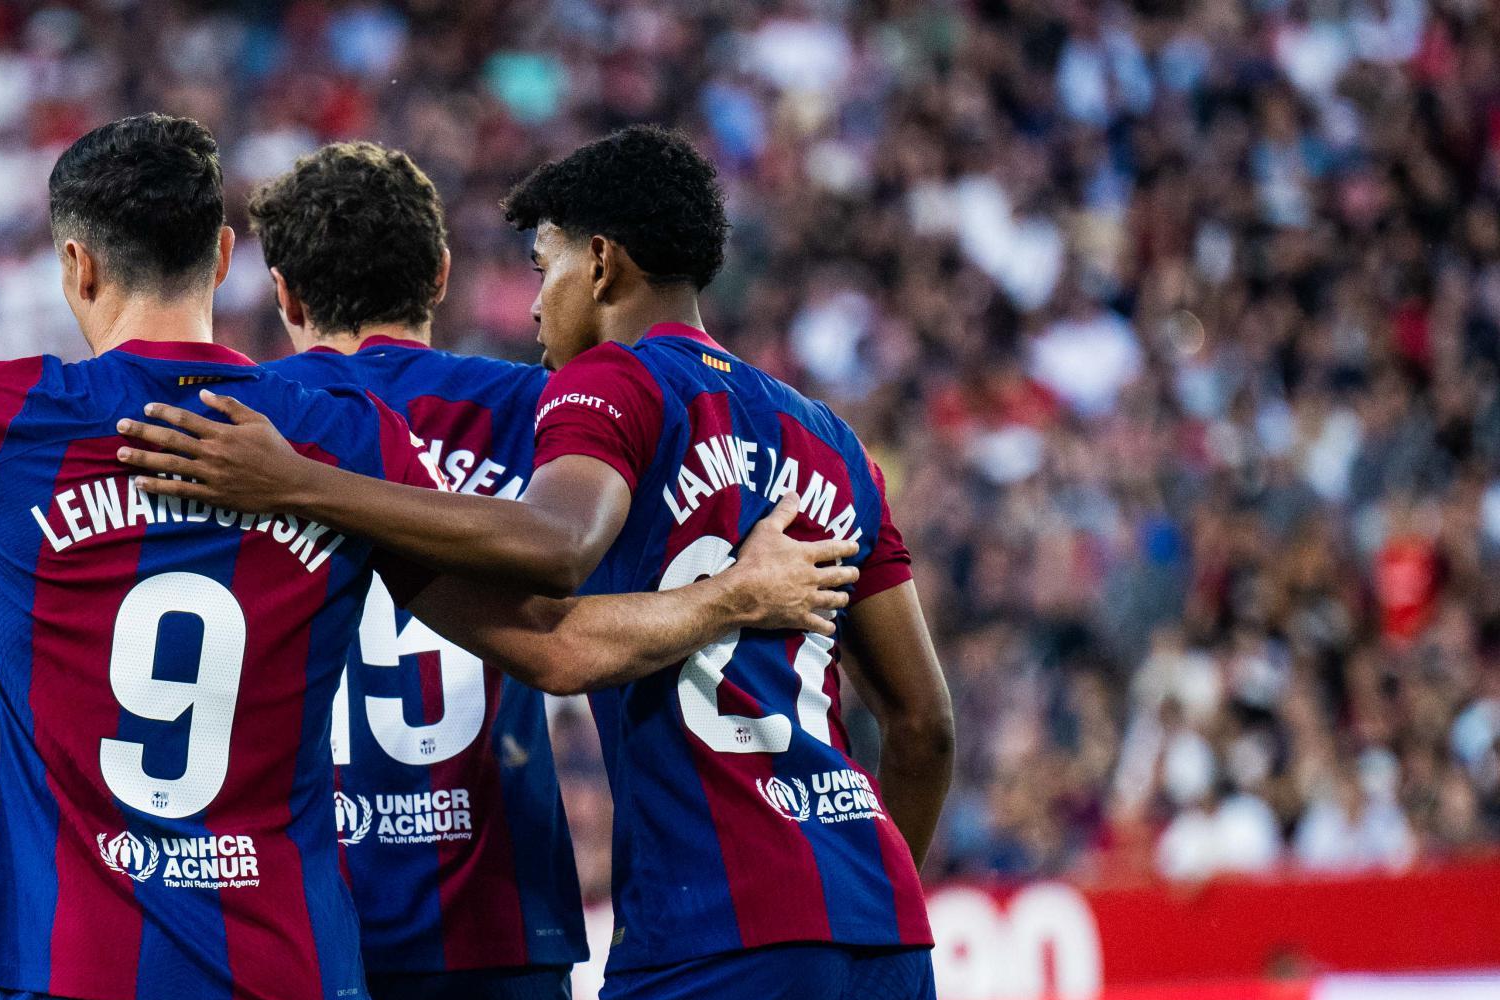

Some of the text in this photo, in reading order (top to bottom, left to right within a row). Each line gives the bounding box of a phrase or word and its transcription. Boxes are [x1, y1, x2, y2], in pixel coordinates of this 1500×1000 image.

[608, 404, 622, 419] tv
[99, 571, 247, 819] 9
[375, 789, 471, 815] UNHCR
[377, 810, 472, 836] ACNUR
[818, 815, 834, 824] The
[835, 814, 849, 823] UN
[160, 834, 258, 858] UNHCR
[378, 832, 472, 844] The UN Refugee Agency
[162, 856, 260, 880] ACNUR
[164, 878, 260, 890] The UN Refugee Agency
